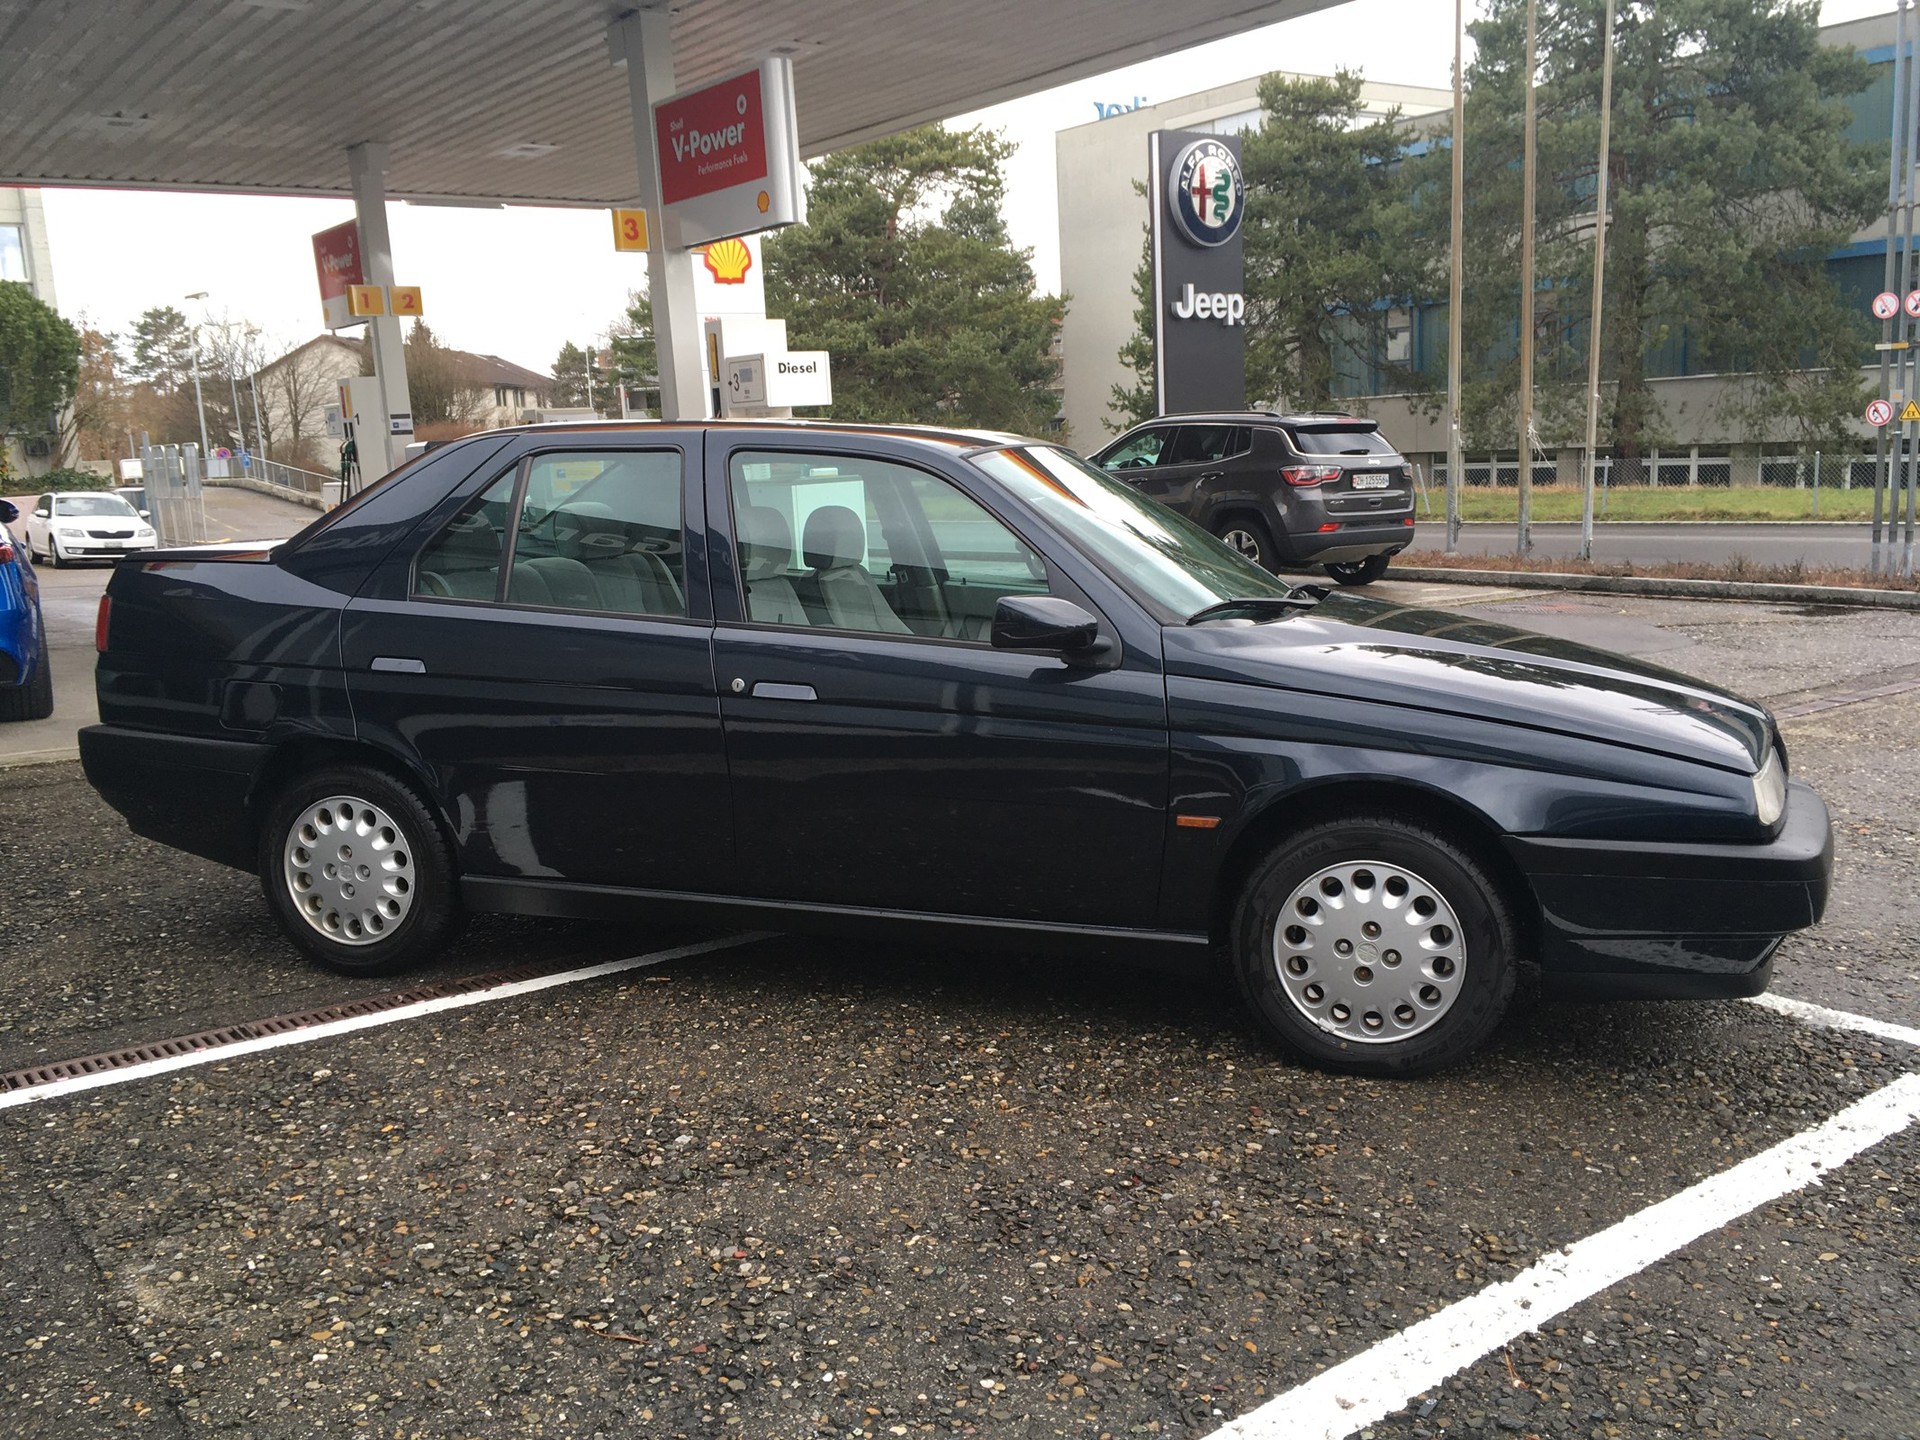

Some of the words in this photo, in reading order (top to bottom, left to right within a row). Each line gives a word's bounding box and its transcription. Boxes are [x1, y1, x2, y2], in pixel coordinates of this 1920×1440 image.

[671, 122, 745, 162] V-Power
[697, 159, 733, 176] Performance
[732, 150, 748, 165] Fuels
[1181, 149, 1204, 192] ALFA
[1208, 144, 1242, 197] ROMEO
[623, 217, 640, 242] 3
[360, 293, 370, 309] 1
[401, 294, 415, 309] 2
[1174, 283, 1244, 326] Jeep
[777, 361, 817, 374] Diesel
[733, 373, 740, 392] 3
[354, 413, 360, 426] 1
